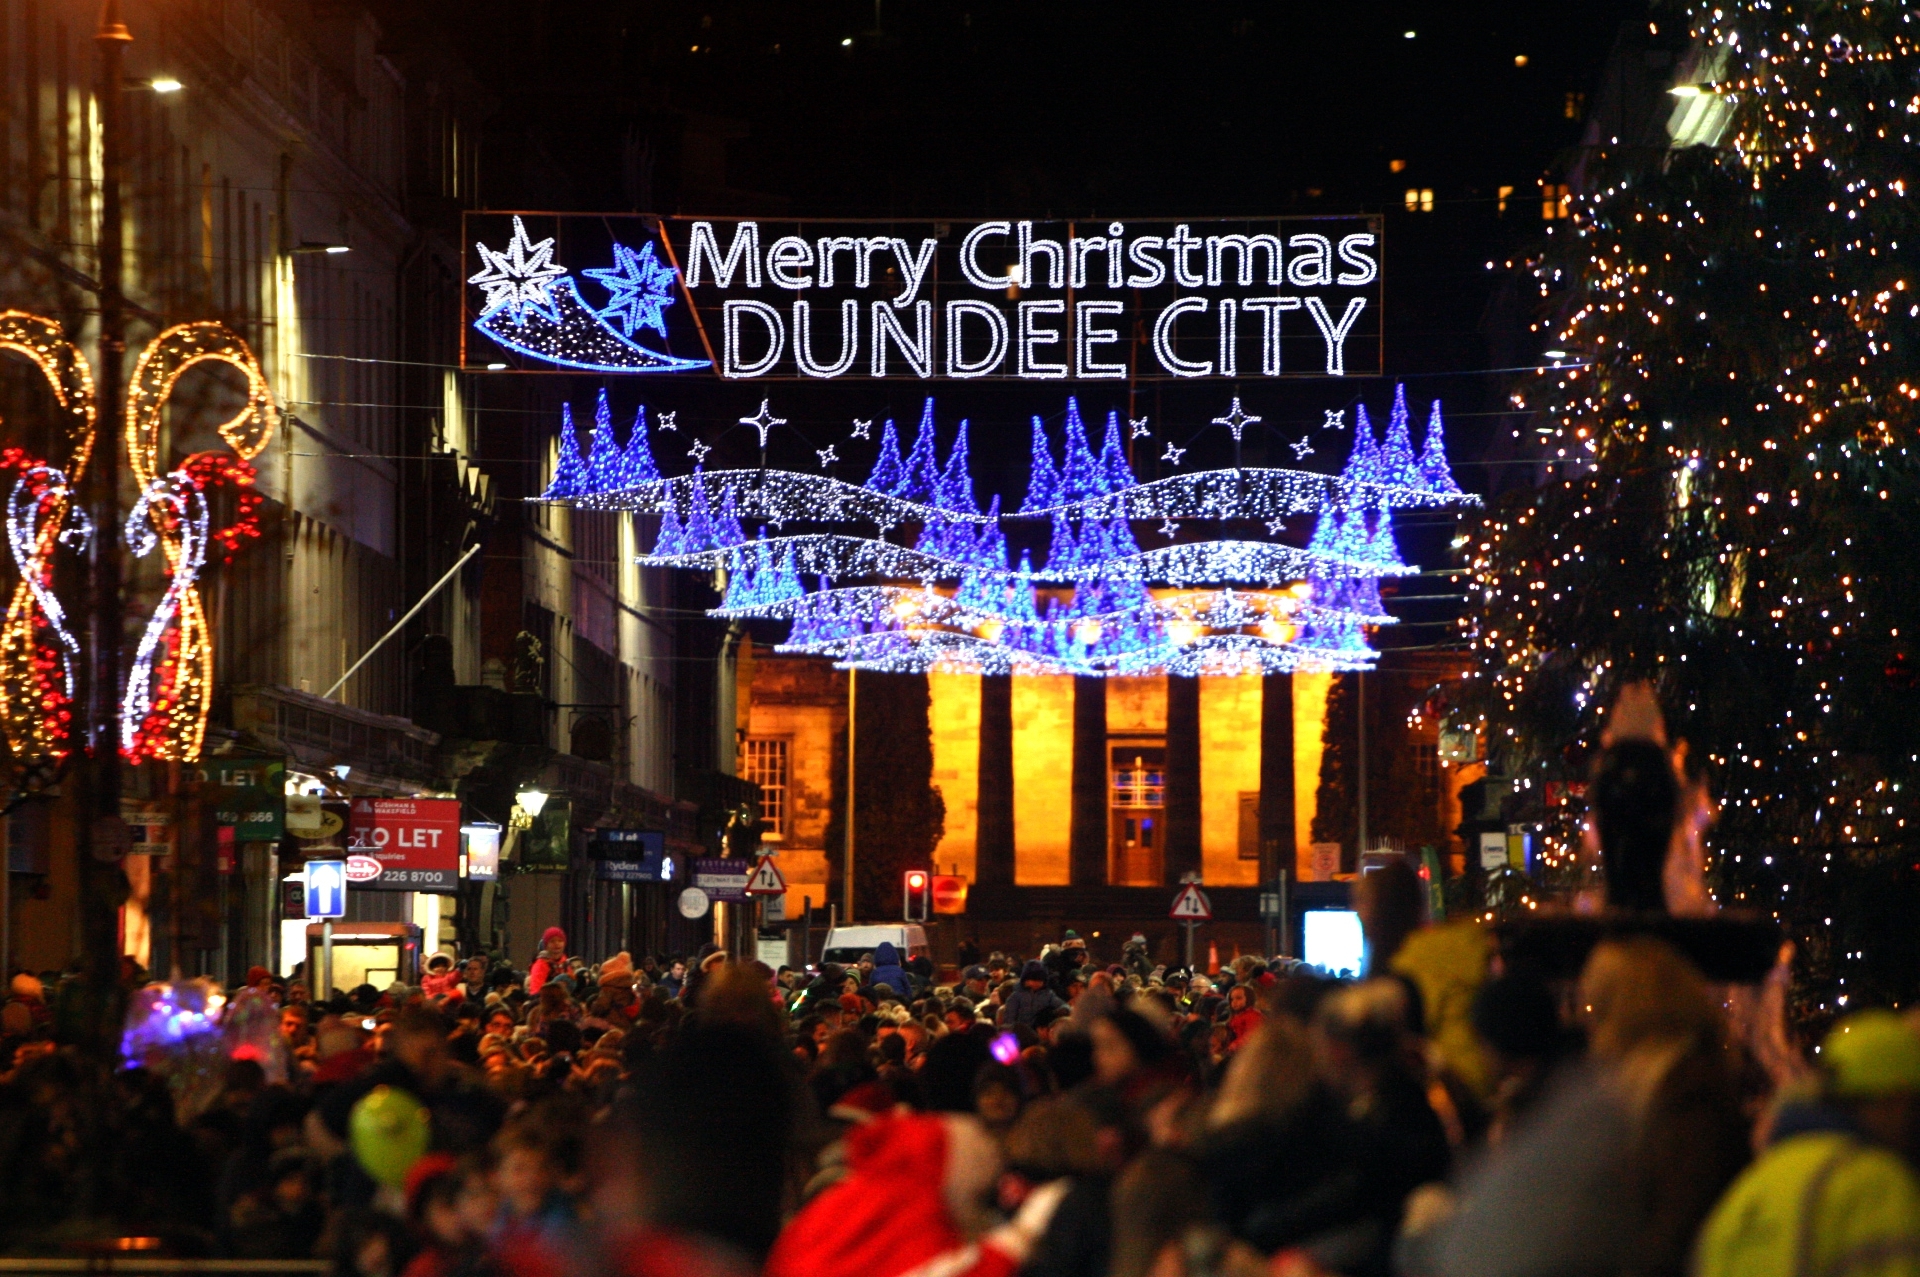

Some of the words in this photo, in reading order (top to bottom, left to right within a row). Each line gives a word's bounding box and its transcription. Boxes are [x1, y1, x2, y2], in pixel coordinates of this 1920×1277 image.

[685, 220, 938, 308] Merry
[959, 220, 1378, 289] Christmas
[723, 299, 1127, 378] DUNDEE
[1152, 296, 1367, 377] CITY
[219, 768, 258, 787] LET
[354, 827, 390, 847] TO
[398, 827, 443, 848] LET
[605, 860, 639, 871] Ryden
[383, 871, 408, 882] 226
[410, 871, 443, 883] 8700
